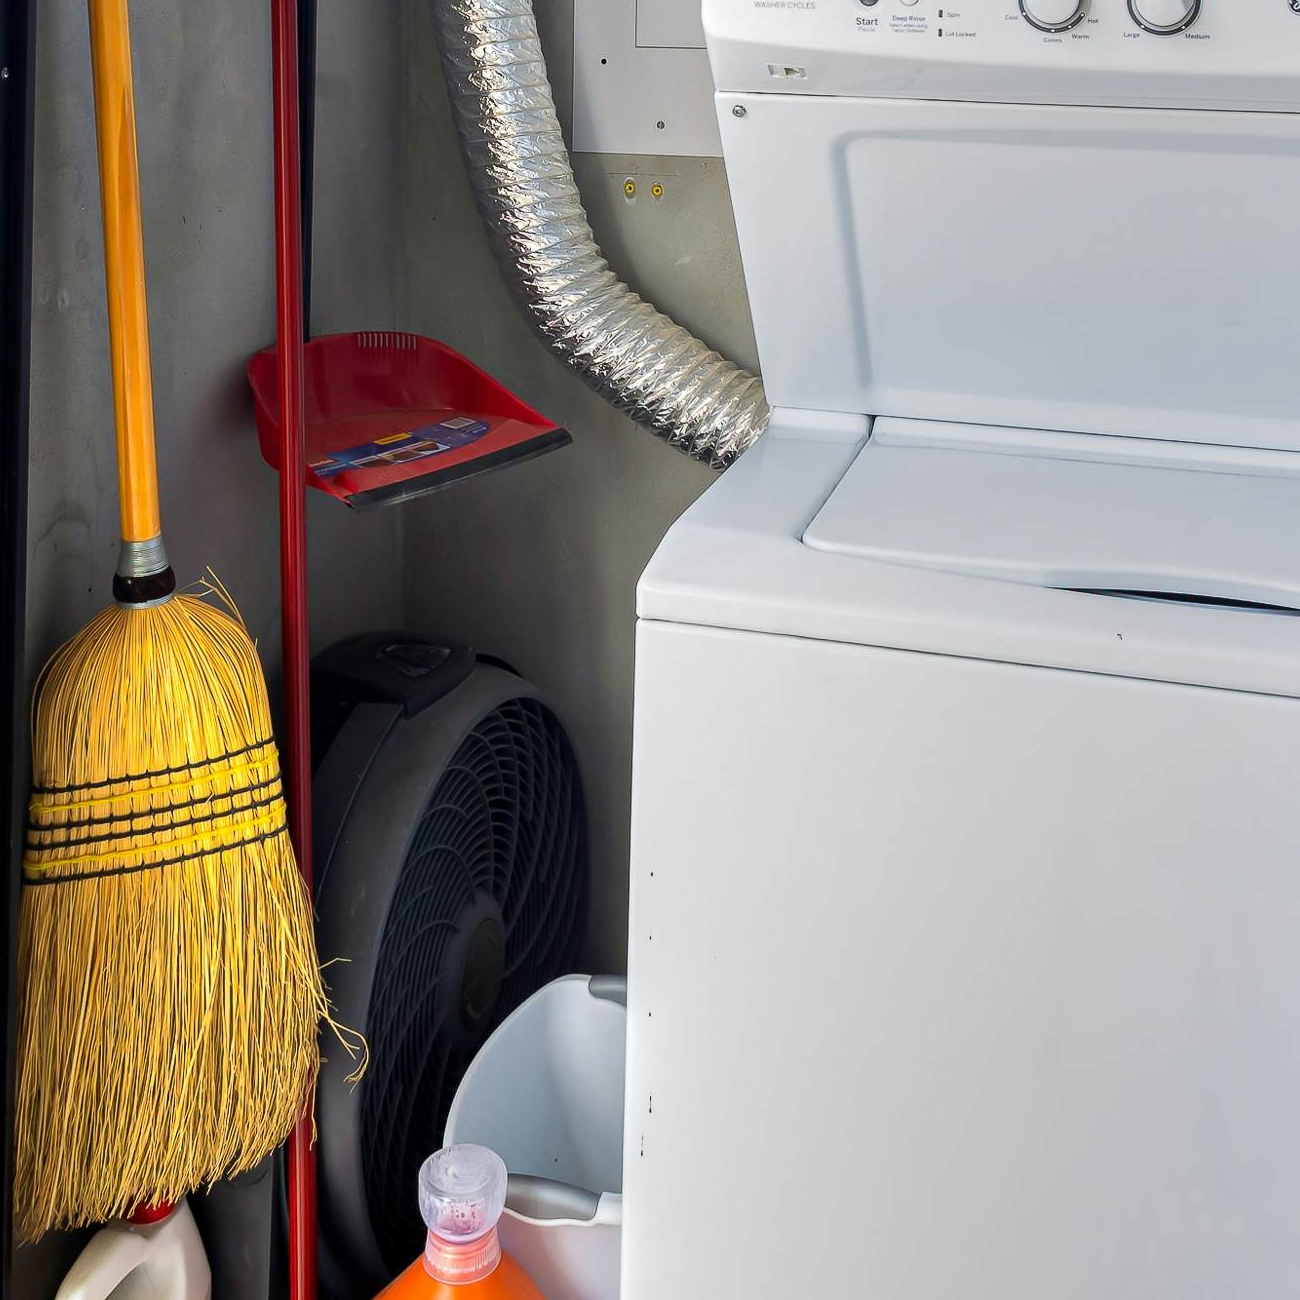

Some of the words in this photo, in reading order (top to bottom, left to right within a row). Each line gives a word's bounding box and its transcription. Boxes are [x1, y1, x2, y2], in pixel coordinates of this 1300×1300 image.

[755, 1, 786, 9] WASHER
[787, 2, 816, 10] CYCLES
[856, 17, 878, 25] Start
